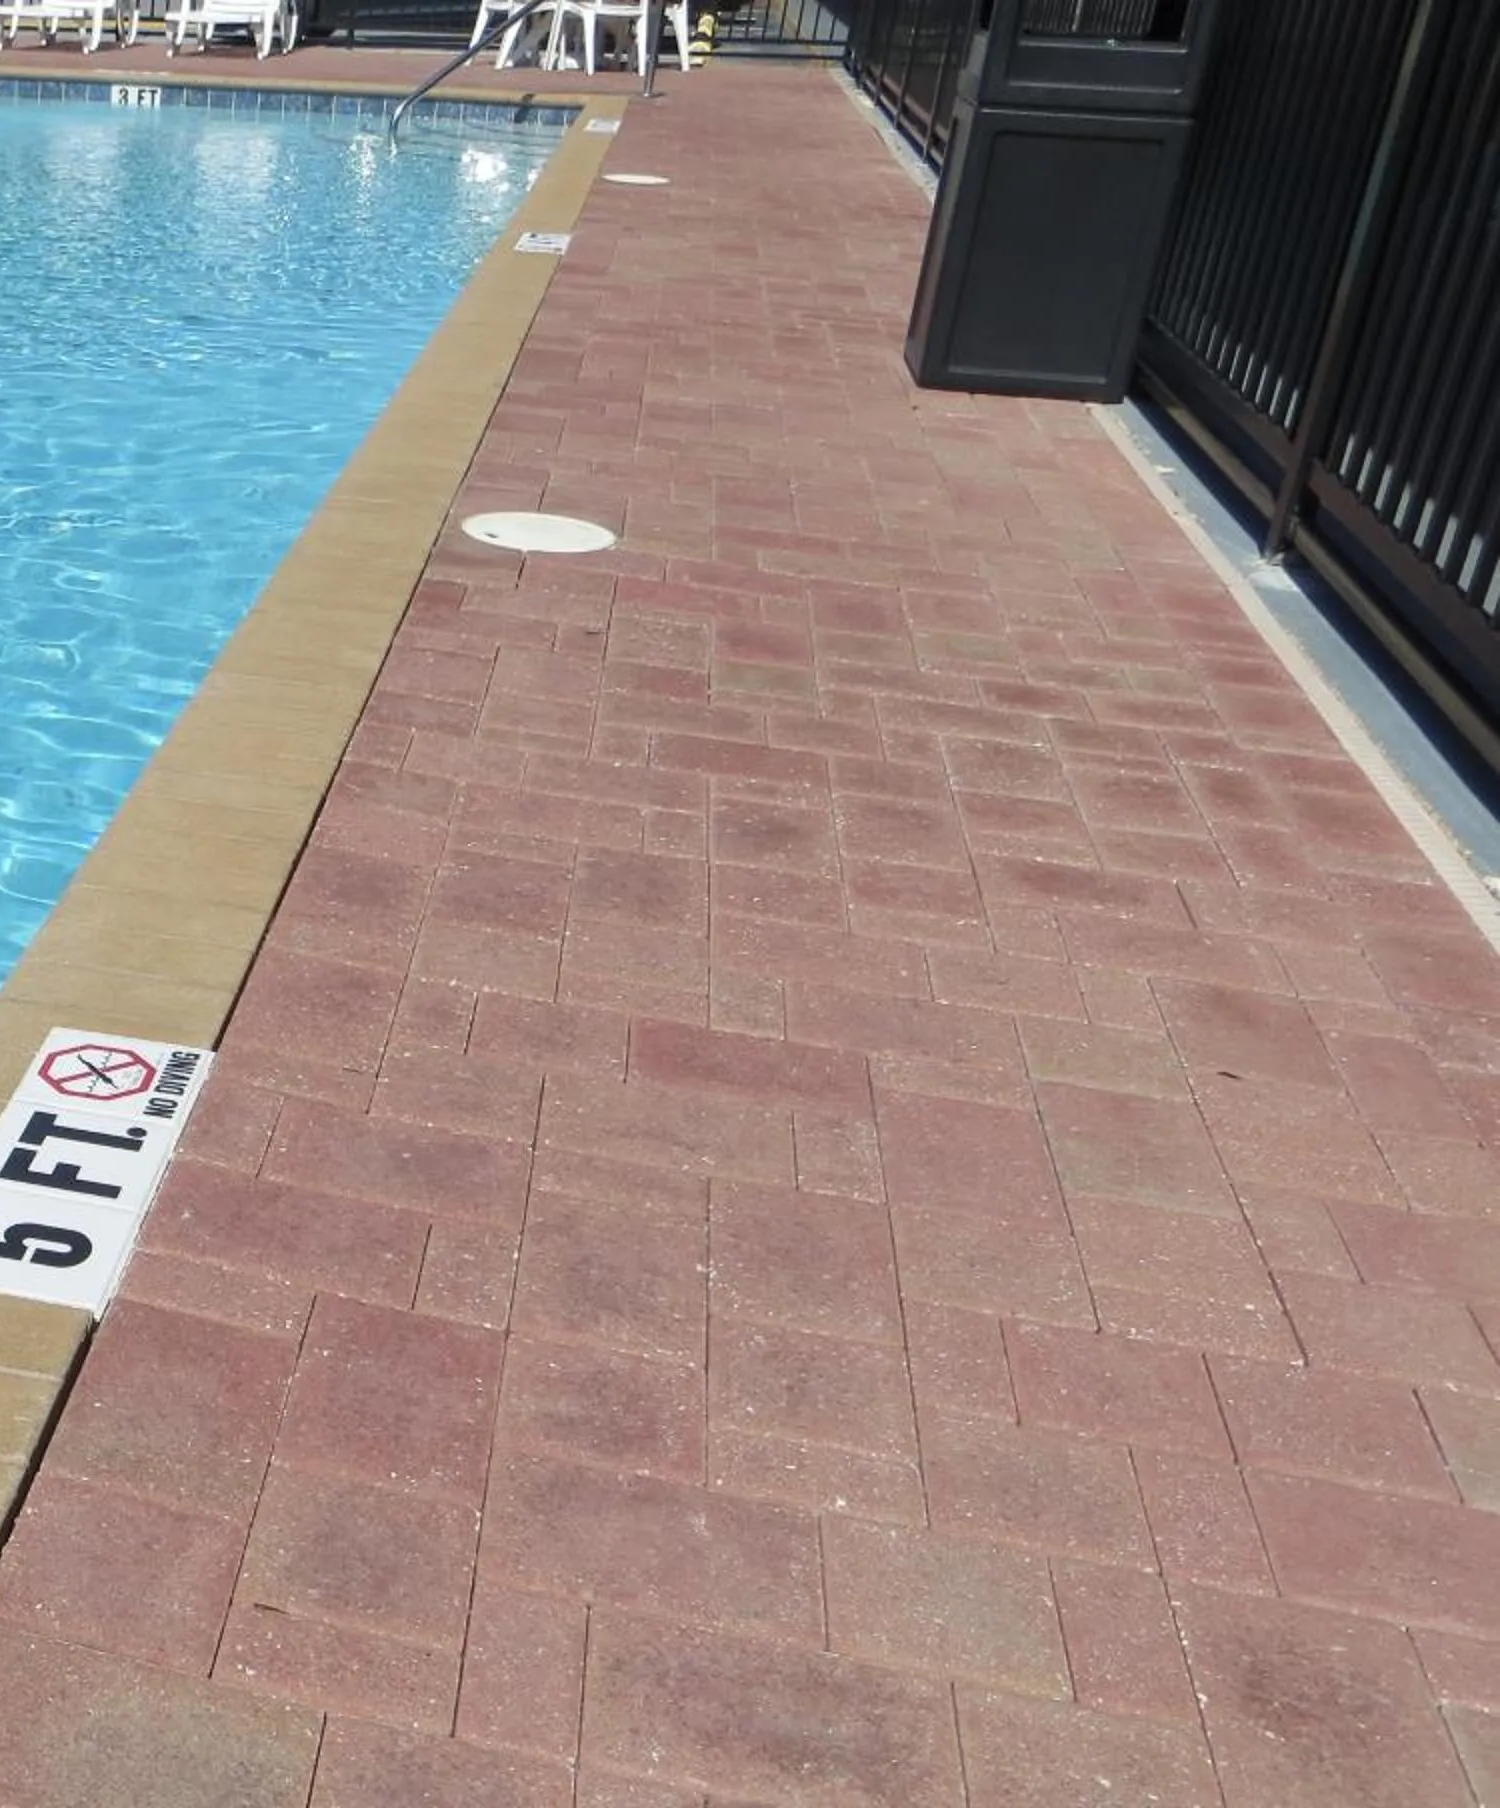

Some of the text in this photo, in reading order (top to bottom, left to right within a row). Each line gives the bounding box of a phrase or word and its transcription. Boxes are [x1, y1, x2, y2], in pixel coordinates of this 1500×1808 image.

[118, 88, 158, 107] 3 FT
[143, 1051, 200, 1118] NO DIVING
